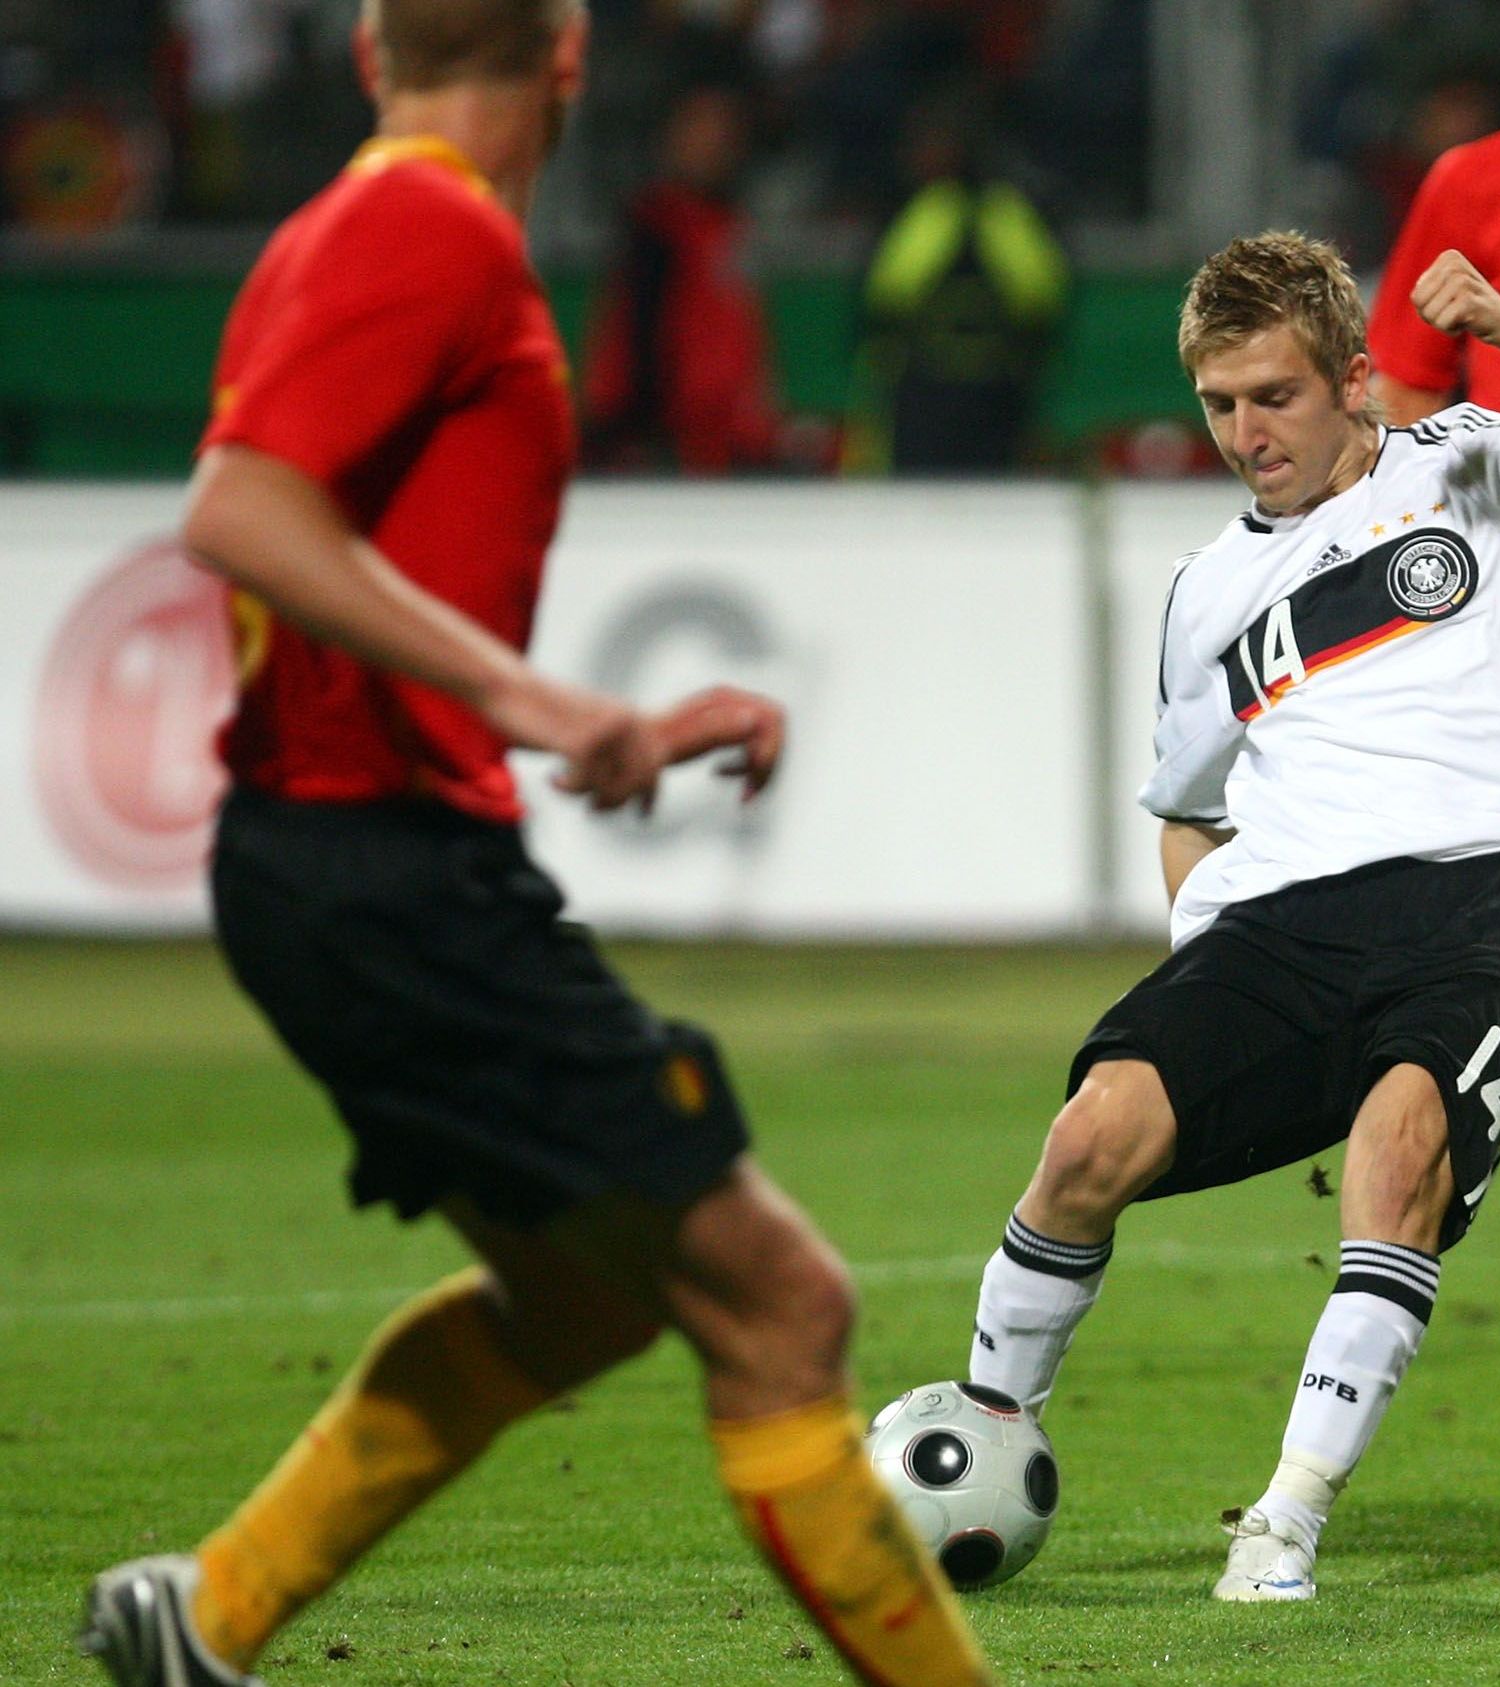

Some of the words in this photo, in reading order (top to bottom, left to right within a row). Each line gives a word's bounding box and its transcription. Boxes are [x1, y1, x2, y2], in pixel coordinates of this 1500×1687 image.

[1306, 549, 1352, 577] adidas
[1238, 597, 1306, 712] 14
[1303, 1373, 1358, 1403] DFB
